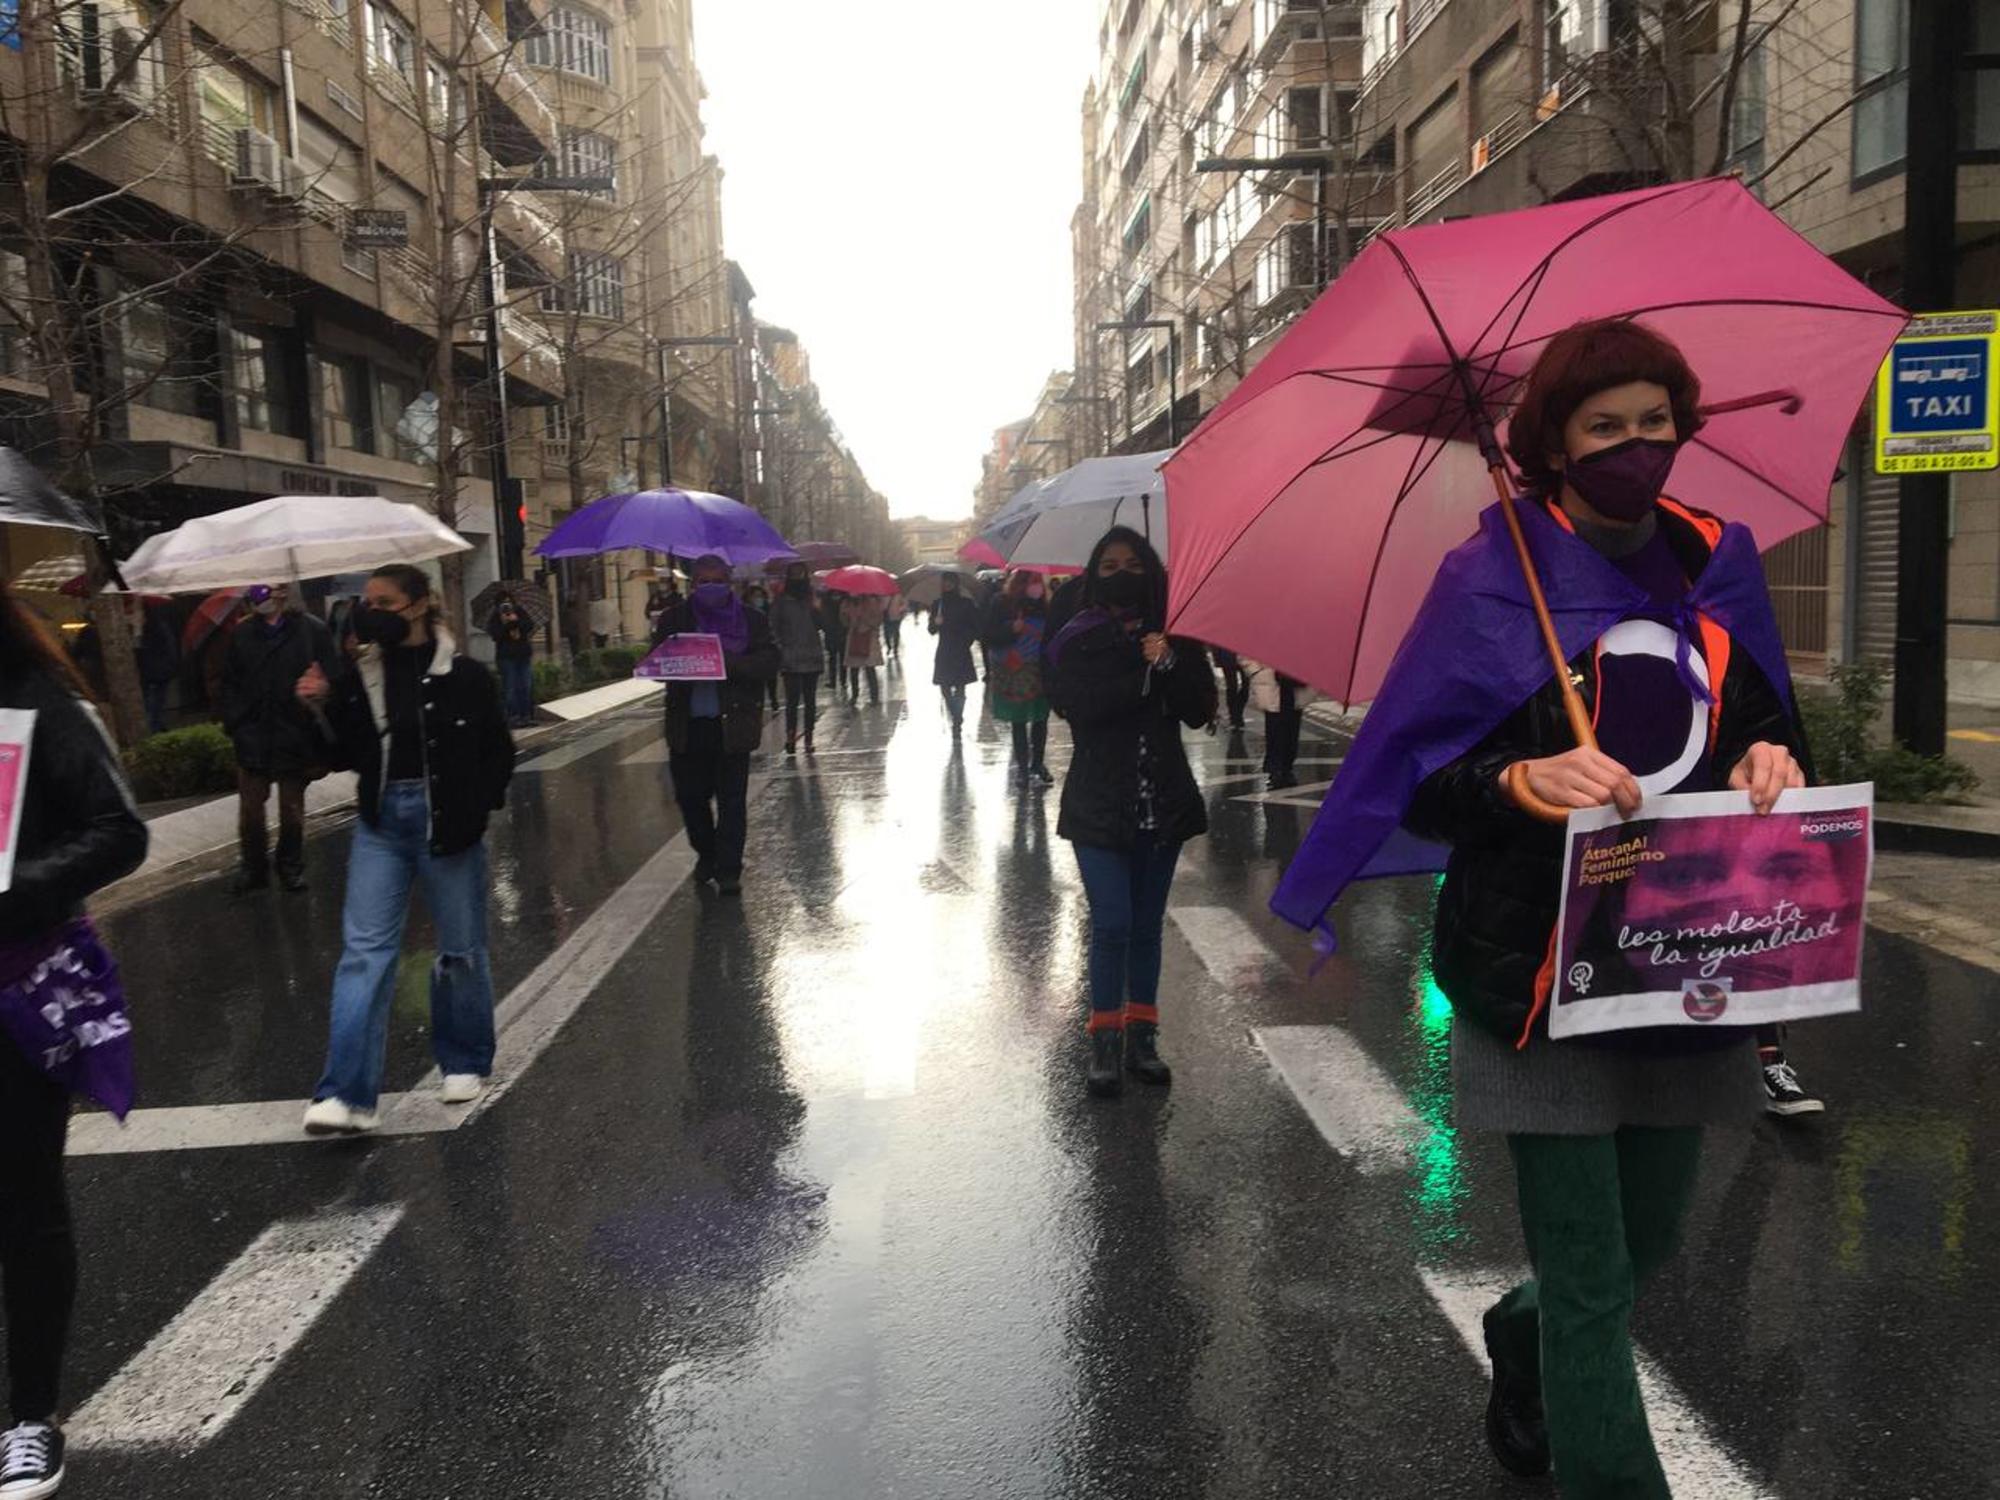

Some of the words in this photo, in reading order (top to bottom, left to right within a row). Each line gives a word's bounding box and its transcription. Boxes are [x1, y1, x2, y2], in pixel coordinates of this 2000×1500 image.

[1906, 395, 1972, 418] TAXI
[1800, 820, 1863, 834] PODEMOS
[1617, 924, 1670, 950] les
[1677, 899, 1808, 942] molesta
[1650, 940, 1688, 966] la
[1697, 912, 1840, 978] igualdad
